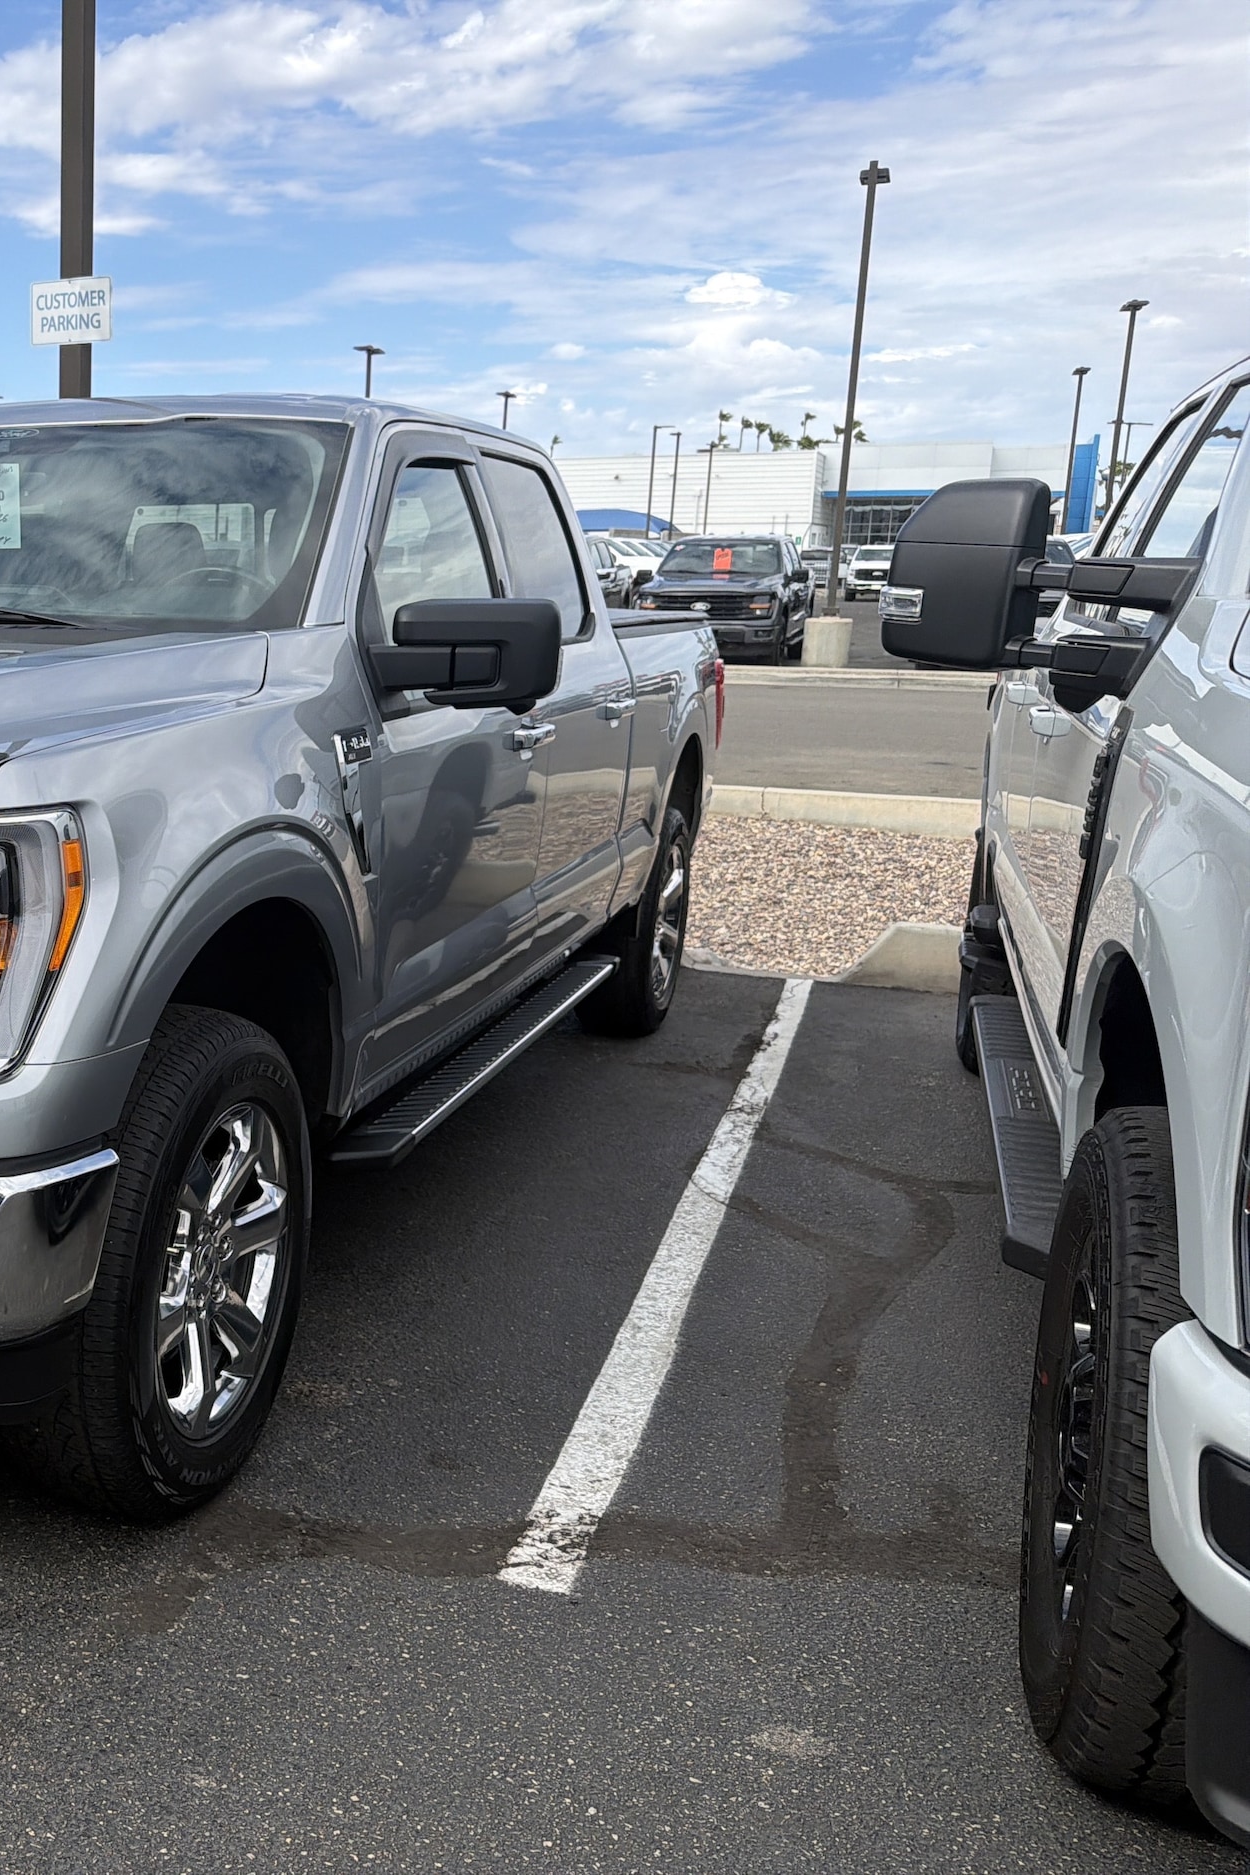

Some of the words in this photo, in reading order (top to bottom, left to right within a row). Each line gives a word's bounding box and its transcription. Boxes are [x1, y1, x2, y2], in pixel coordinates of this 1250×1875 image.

[36, 289, 106, 311] CUSTOMER
[41, 312, 101, 333] PARKING
[231, 1062, 289, 1088] PIRELLI
